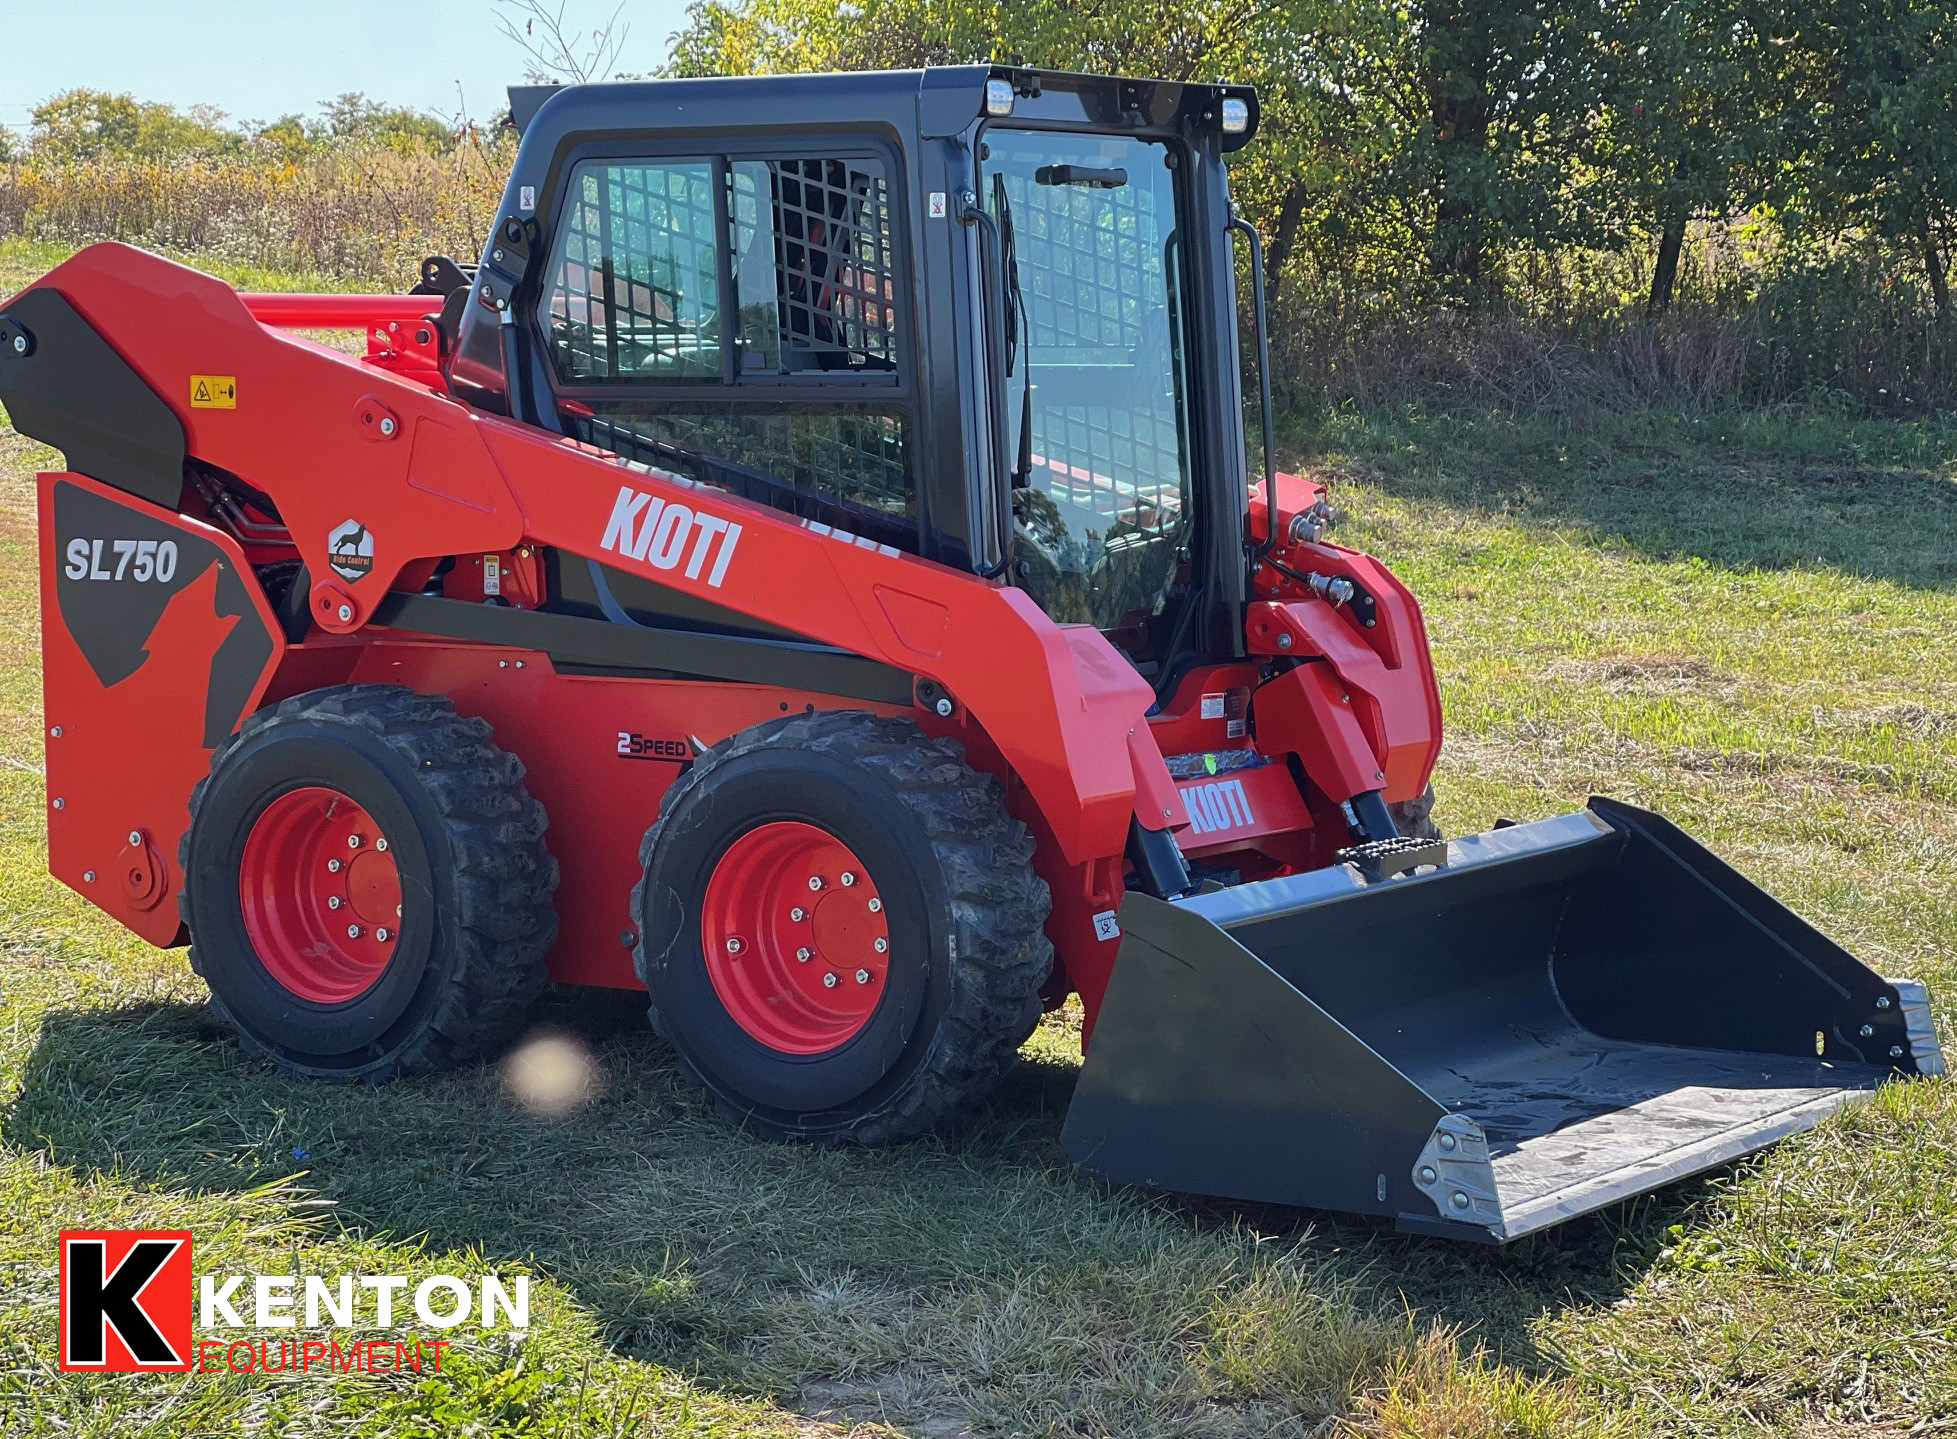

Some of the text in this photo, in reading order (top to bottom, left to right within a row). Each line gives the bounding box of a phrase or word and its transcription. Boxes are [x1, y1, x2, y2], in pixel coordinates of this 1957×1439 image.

[65, 538, 178, 583] SL750
[600, 486, 743, 588] KIOTI
[1180, 779, 1255, 835] KIOTI
